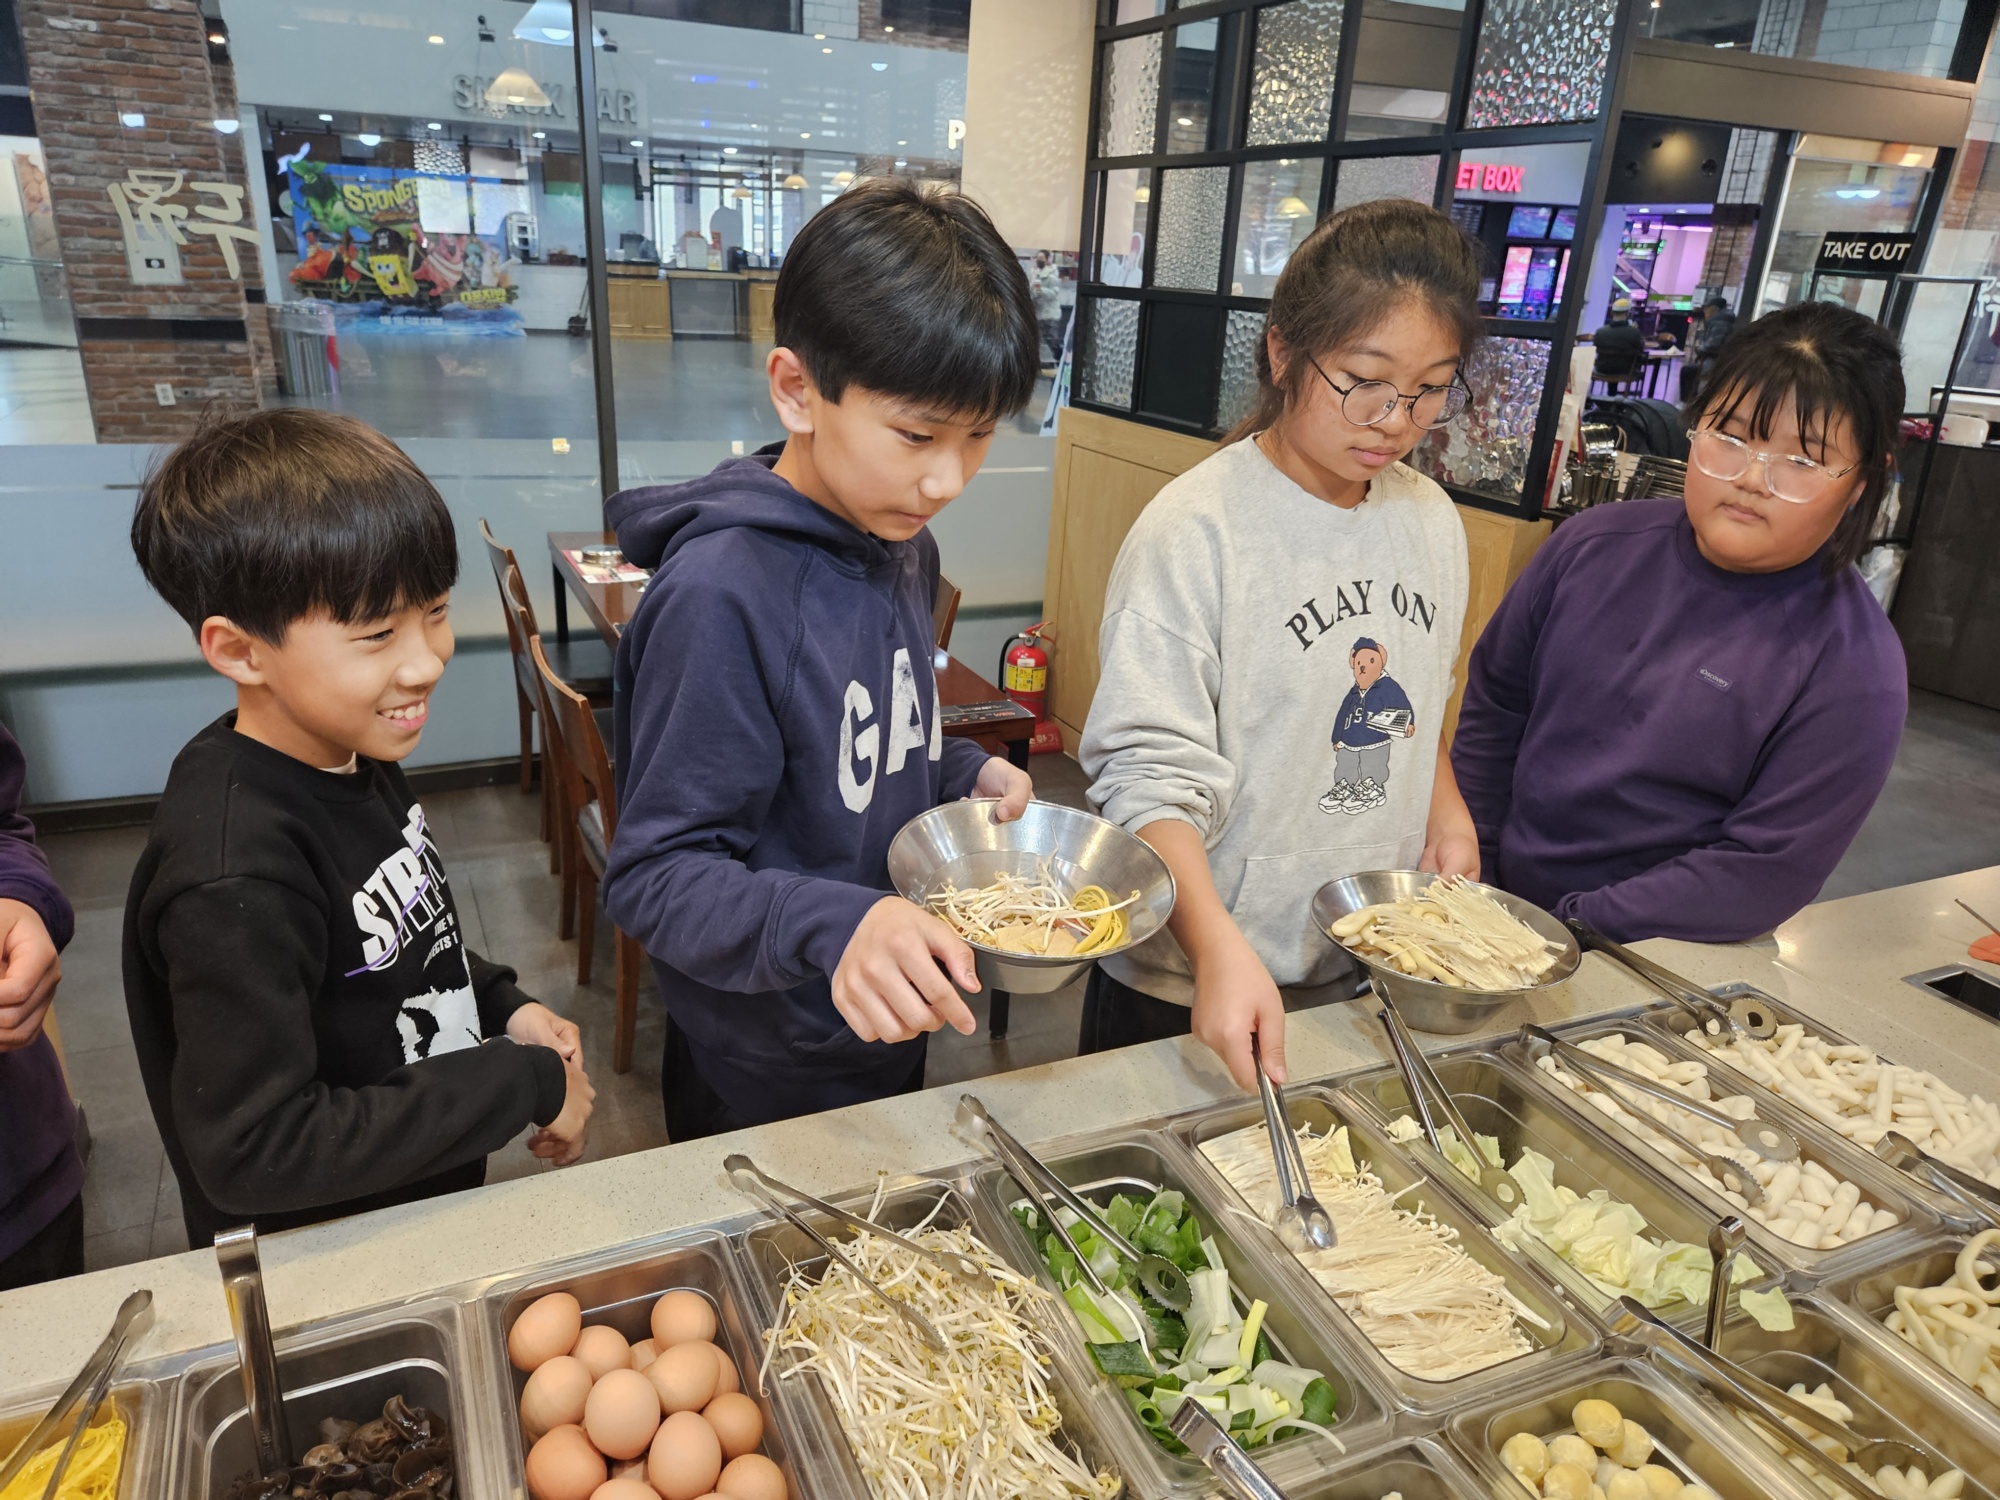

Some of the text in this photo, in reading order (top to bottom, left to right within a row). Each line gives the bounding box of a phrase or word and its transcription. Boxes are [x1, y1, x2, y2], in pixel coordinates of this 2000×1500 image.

[1482, 164, 1525, 192] BOX
[1823, 241, 1911, 261] TAKE OUT
[1285, 580, 1437, 651] PLAY ON
